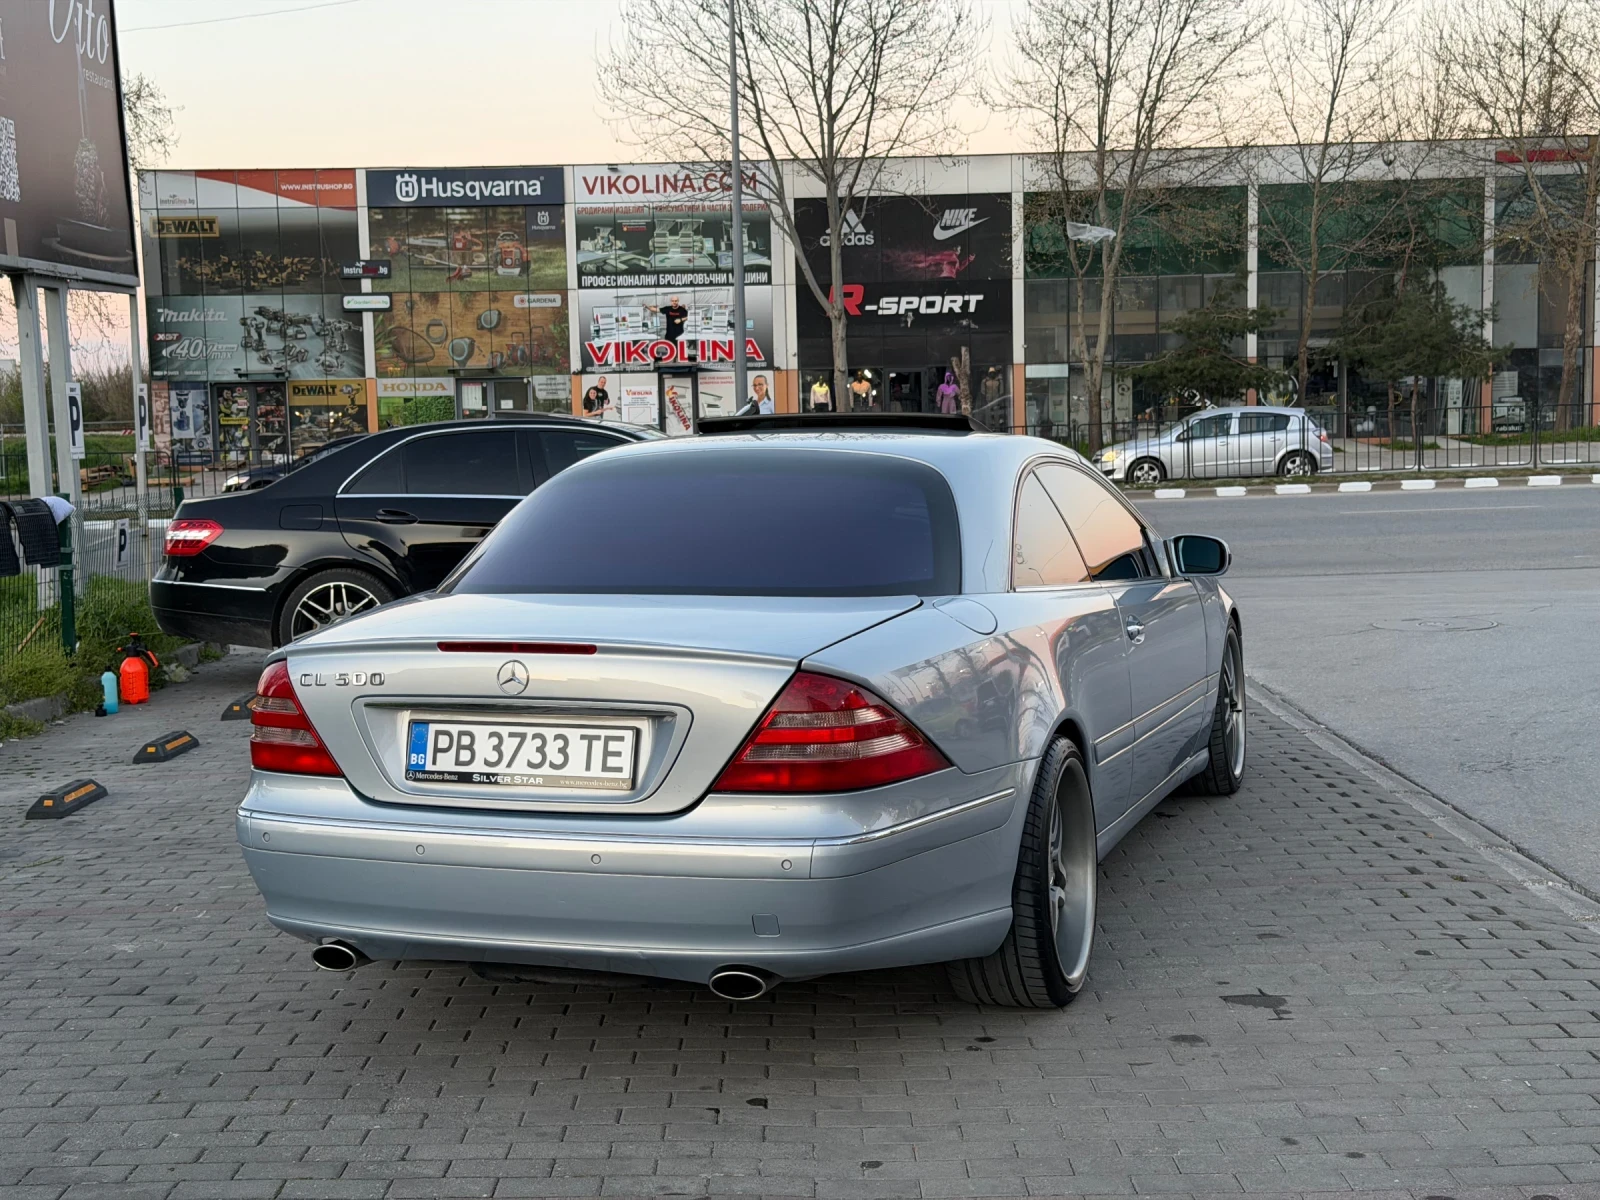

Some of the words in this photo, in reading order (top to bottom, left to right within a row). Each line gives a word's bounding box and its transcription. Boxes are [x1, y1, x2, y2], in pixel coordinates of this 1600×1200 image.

[83, 68, 114, 91] restaurant
[280, 183, 353, 191] WWW.INSTRUSHOP.BG
[421, 177, 541, 200] Husqvarna
[582, 172, 757, 195] VIKOLINA.COM
[577, 206, 613, 215] БРОДИРАНИ
[616, 205, 644, 214] ИЗДЕЛИЯ
[707, 203, 726, 212] ЧАСТИ
[941, 208, 977, 227] NIKE
[820, 232, 875, 247] aidas
[581, 274, 657, 287] ПРОФЕСИОНАЛНИ
[659, 273, 726, 286] БРОДИРОВЪЧНИ
[728, 272, 768, 285] МШИНИ
[827, 284, 984, 316] R-SPORT
[585, 338, 765, 365] VIKOLINA
[383, 382, 448, 392] HONDA
[68, 396, 81, 446] P
[138, 396, 147, 440] P
[118, 528, 127, 562] P
[300, 672, 327, 687] CL
[335, 671, 385, 687] 500
[411, 753, 425, 765] BG
[432, 729, 477, 767] PB
[484, 731, 569, 771] 3733
[580, 734, 625, 773] TE
[416, 772, 459, 781] Mercedes-Benz
[472, 773, 512, 783] SILVER
[513, 775, 544, 785] STAR
[560, 778, 627, 788] www.mercedes-benz.bg
